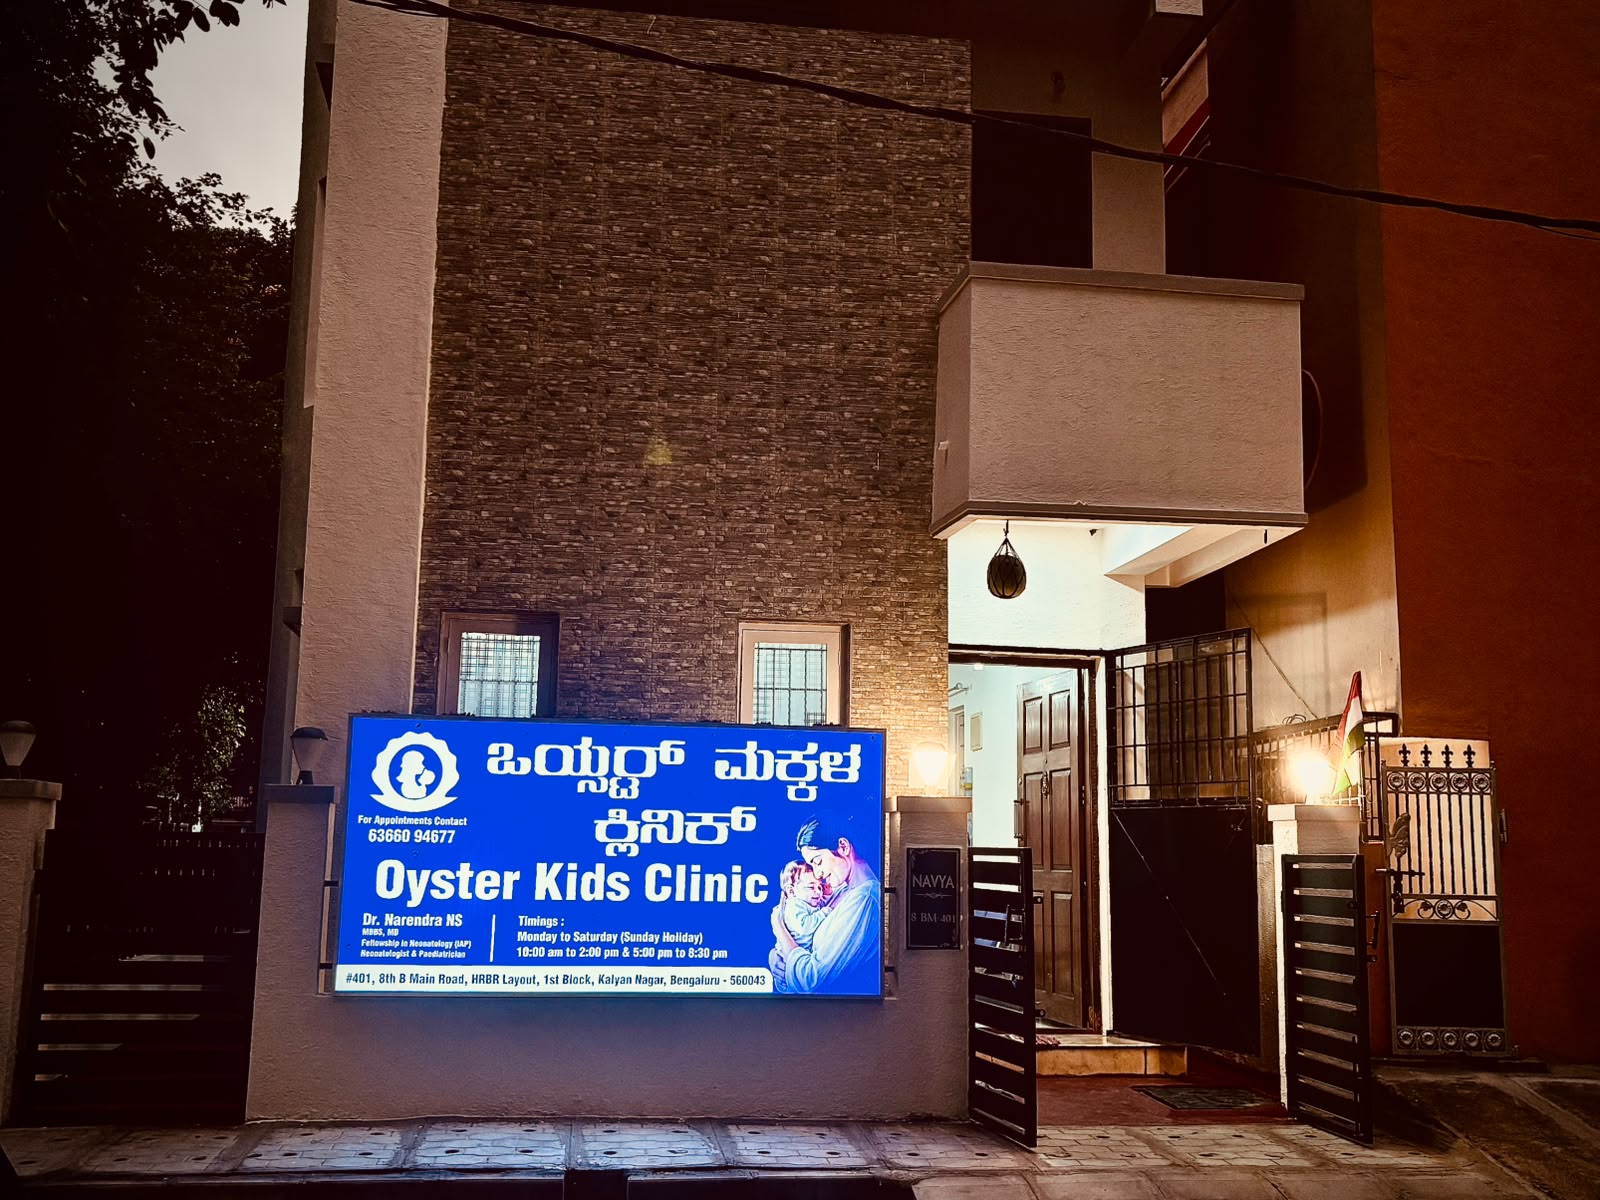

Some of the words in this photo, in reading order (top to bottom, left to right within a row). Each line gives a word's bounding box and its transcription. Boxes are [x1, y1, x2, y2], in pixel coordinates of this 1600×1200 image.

[714, 740, 862, 802] ಮಕ್ಕಳ
[357, 814, 372, 824] For
[373, 815, 433, 826] Appointments
[434, 816, 468, 826] Contact
[368, 828, 411, 843] 63660
[413, 829, 456, 844] 94677
[593, 805, 757, 857] ಕ್ಲಿನಿಕ್
[375, 859, 521, 908] Oyster
[534, 862, 631, 902] Kids
[644, 863, 769, 904] Clinic
[912, 873, 955, 889] NAVYA
[362, 912, 380, 926] Dr.
[384, 913, 443, 927] Narendra
[445, 913, 463, 927] NS
[518, 915, 559, 928] Timings
[362, 928, 386, 937] MBBS,
[387, 928, 399, 937] MD
[517, 931, 558, 944] Monday
[560, 932, 571, 943] to
[573, 932, 618, 944] Saturday
[620, 932, 661, 945] (Sunday
[662, 932, 703, 945] Holiday)
[361, 938, 400, 948] Fellowship
[409, 939, 453, 949] Neonatology
[454, 940, 472, 949] (IAP)
[360, 949, 410, 959] Neonatologist
[411, 950, 417, 958] &
[418, 950, 466, 959] Paediatrician
[516, 946, 545, 958] 10:00
[547, 949, 564, 958] am
[565, 947, 577, 958] to
[578, 947, 602, 958] 2:00
[604, 949, 619, 959] pm
[622, 947, 630, 958] &
[632, 947, 656, 958] 5:00
[657, 949, 673, 960] pm
[675, 948, 686, 959] to
[688, 948, 710, 959] 8:30
[712, 949, 728, 960] pm
[345, 973, 375, 985] #401,
[379, 973, 396, 984] 8th
[399, 974, 406, 984] B
[409, 974, 435, 984] Main
[438, 974, 468, 986] Road,
[471, 974, 499, 984] HRBR
[502, 974, 540, 987] Layout,
[544, 974, 559, 985] 1st
[563, 974, 595, 987] Block,
[598, 975, 632, 986] Kalyan
[635, 975, 667, 987] Nagar,
[670, 975, 720, 987] Bengaluru
[730, 975, 766, 986] 560043
